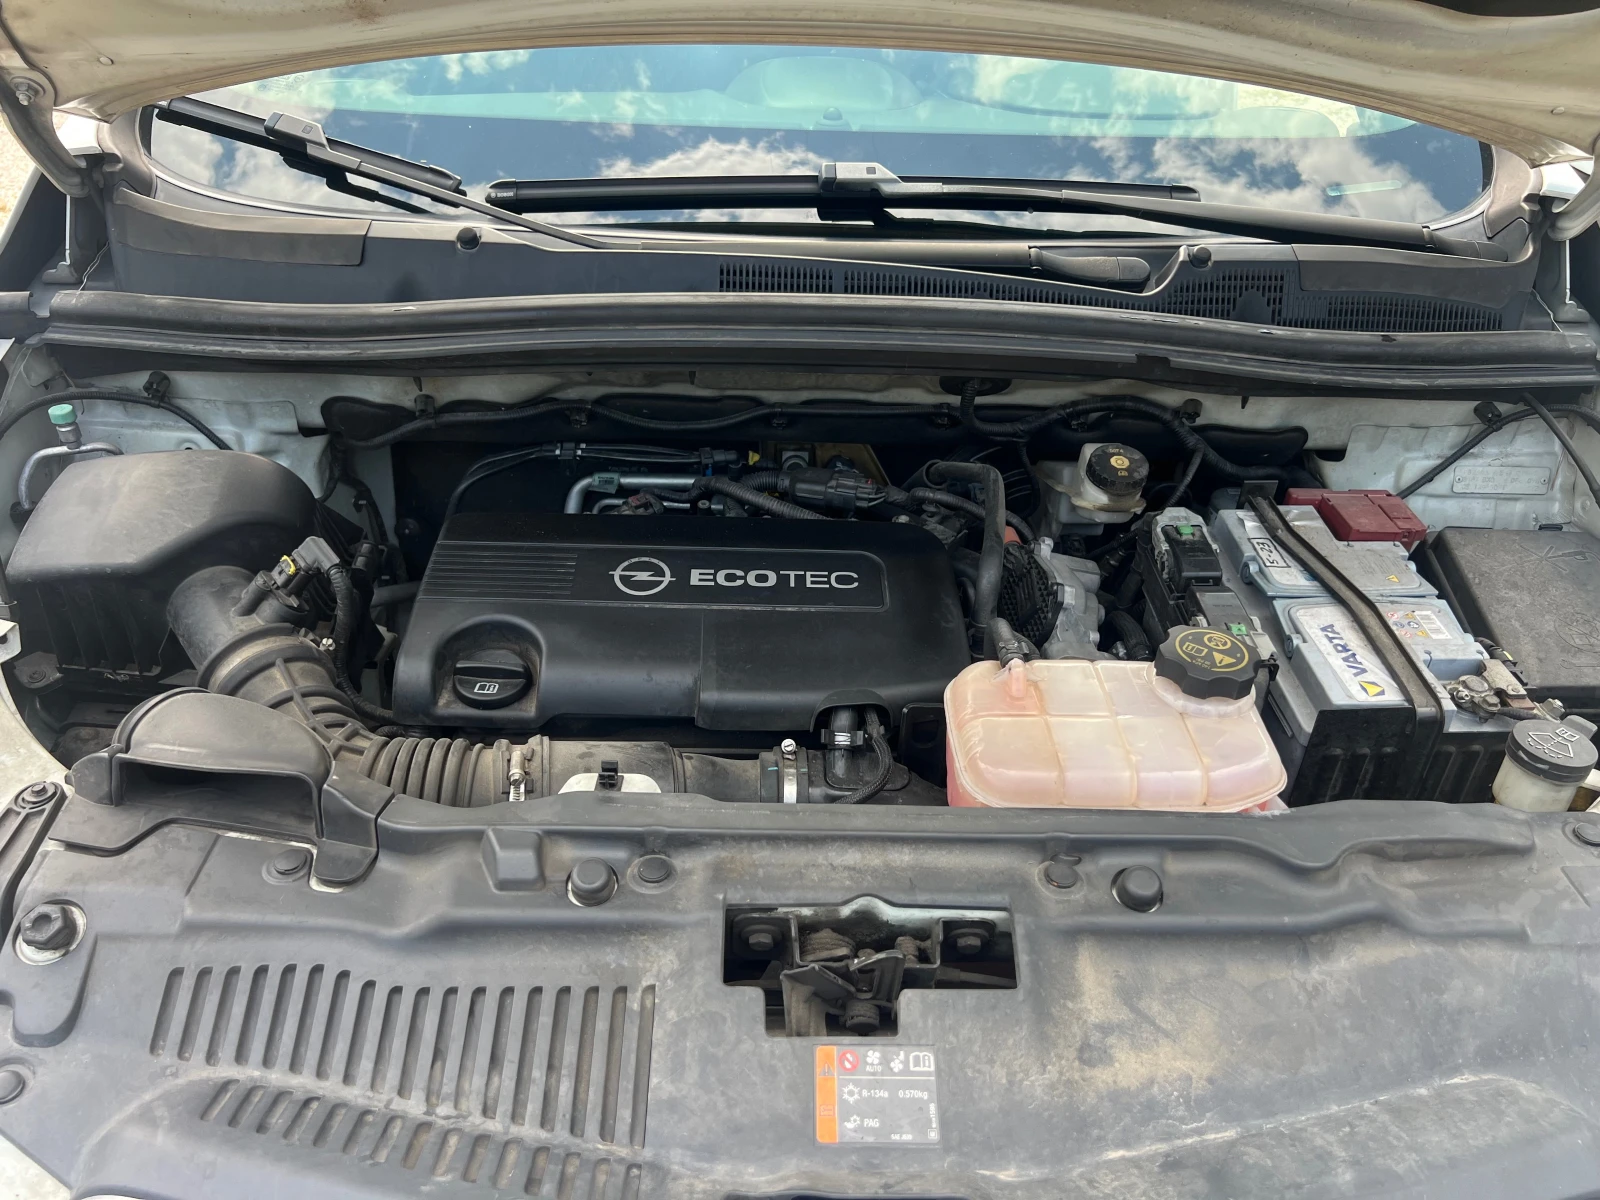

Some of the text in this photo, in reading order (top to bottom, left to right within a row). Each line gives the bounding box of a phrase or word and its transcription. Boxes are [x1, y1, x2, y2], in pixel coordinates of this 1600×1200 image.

[689, 568, 859, 589] ECOTEC
[1319, 623, 1368, 678] VARTA
[861, 1089, 928, 1099] R-134a 0.570kg
[863, 1118, 880, 1128] PAG
